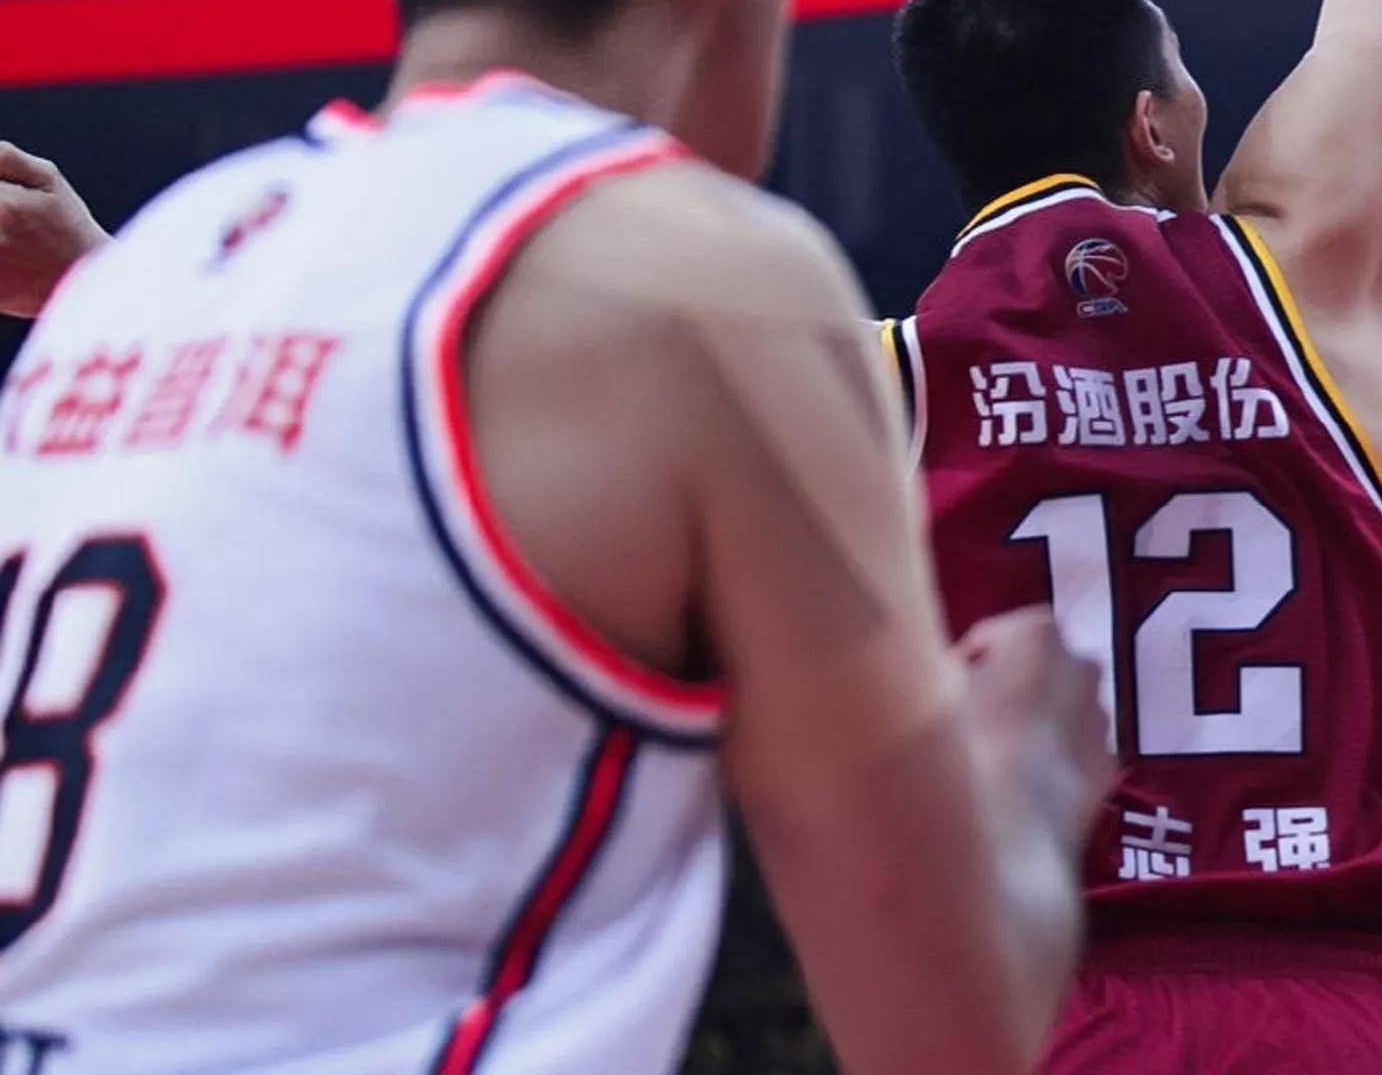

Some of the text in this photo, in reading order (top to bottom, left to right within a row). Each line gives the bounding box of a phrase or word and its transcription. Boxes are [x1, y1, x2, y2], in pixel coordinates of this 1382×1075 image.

[969, 356, 1291, 447] 汾酒股份
[0, 530, 169, 955] 8
[1008, 490, 1304, 756] 12
